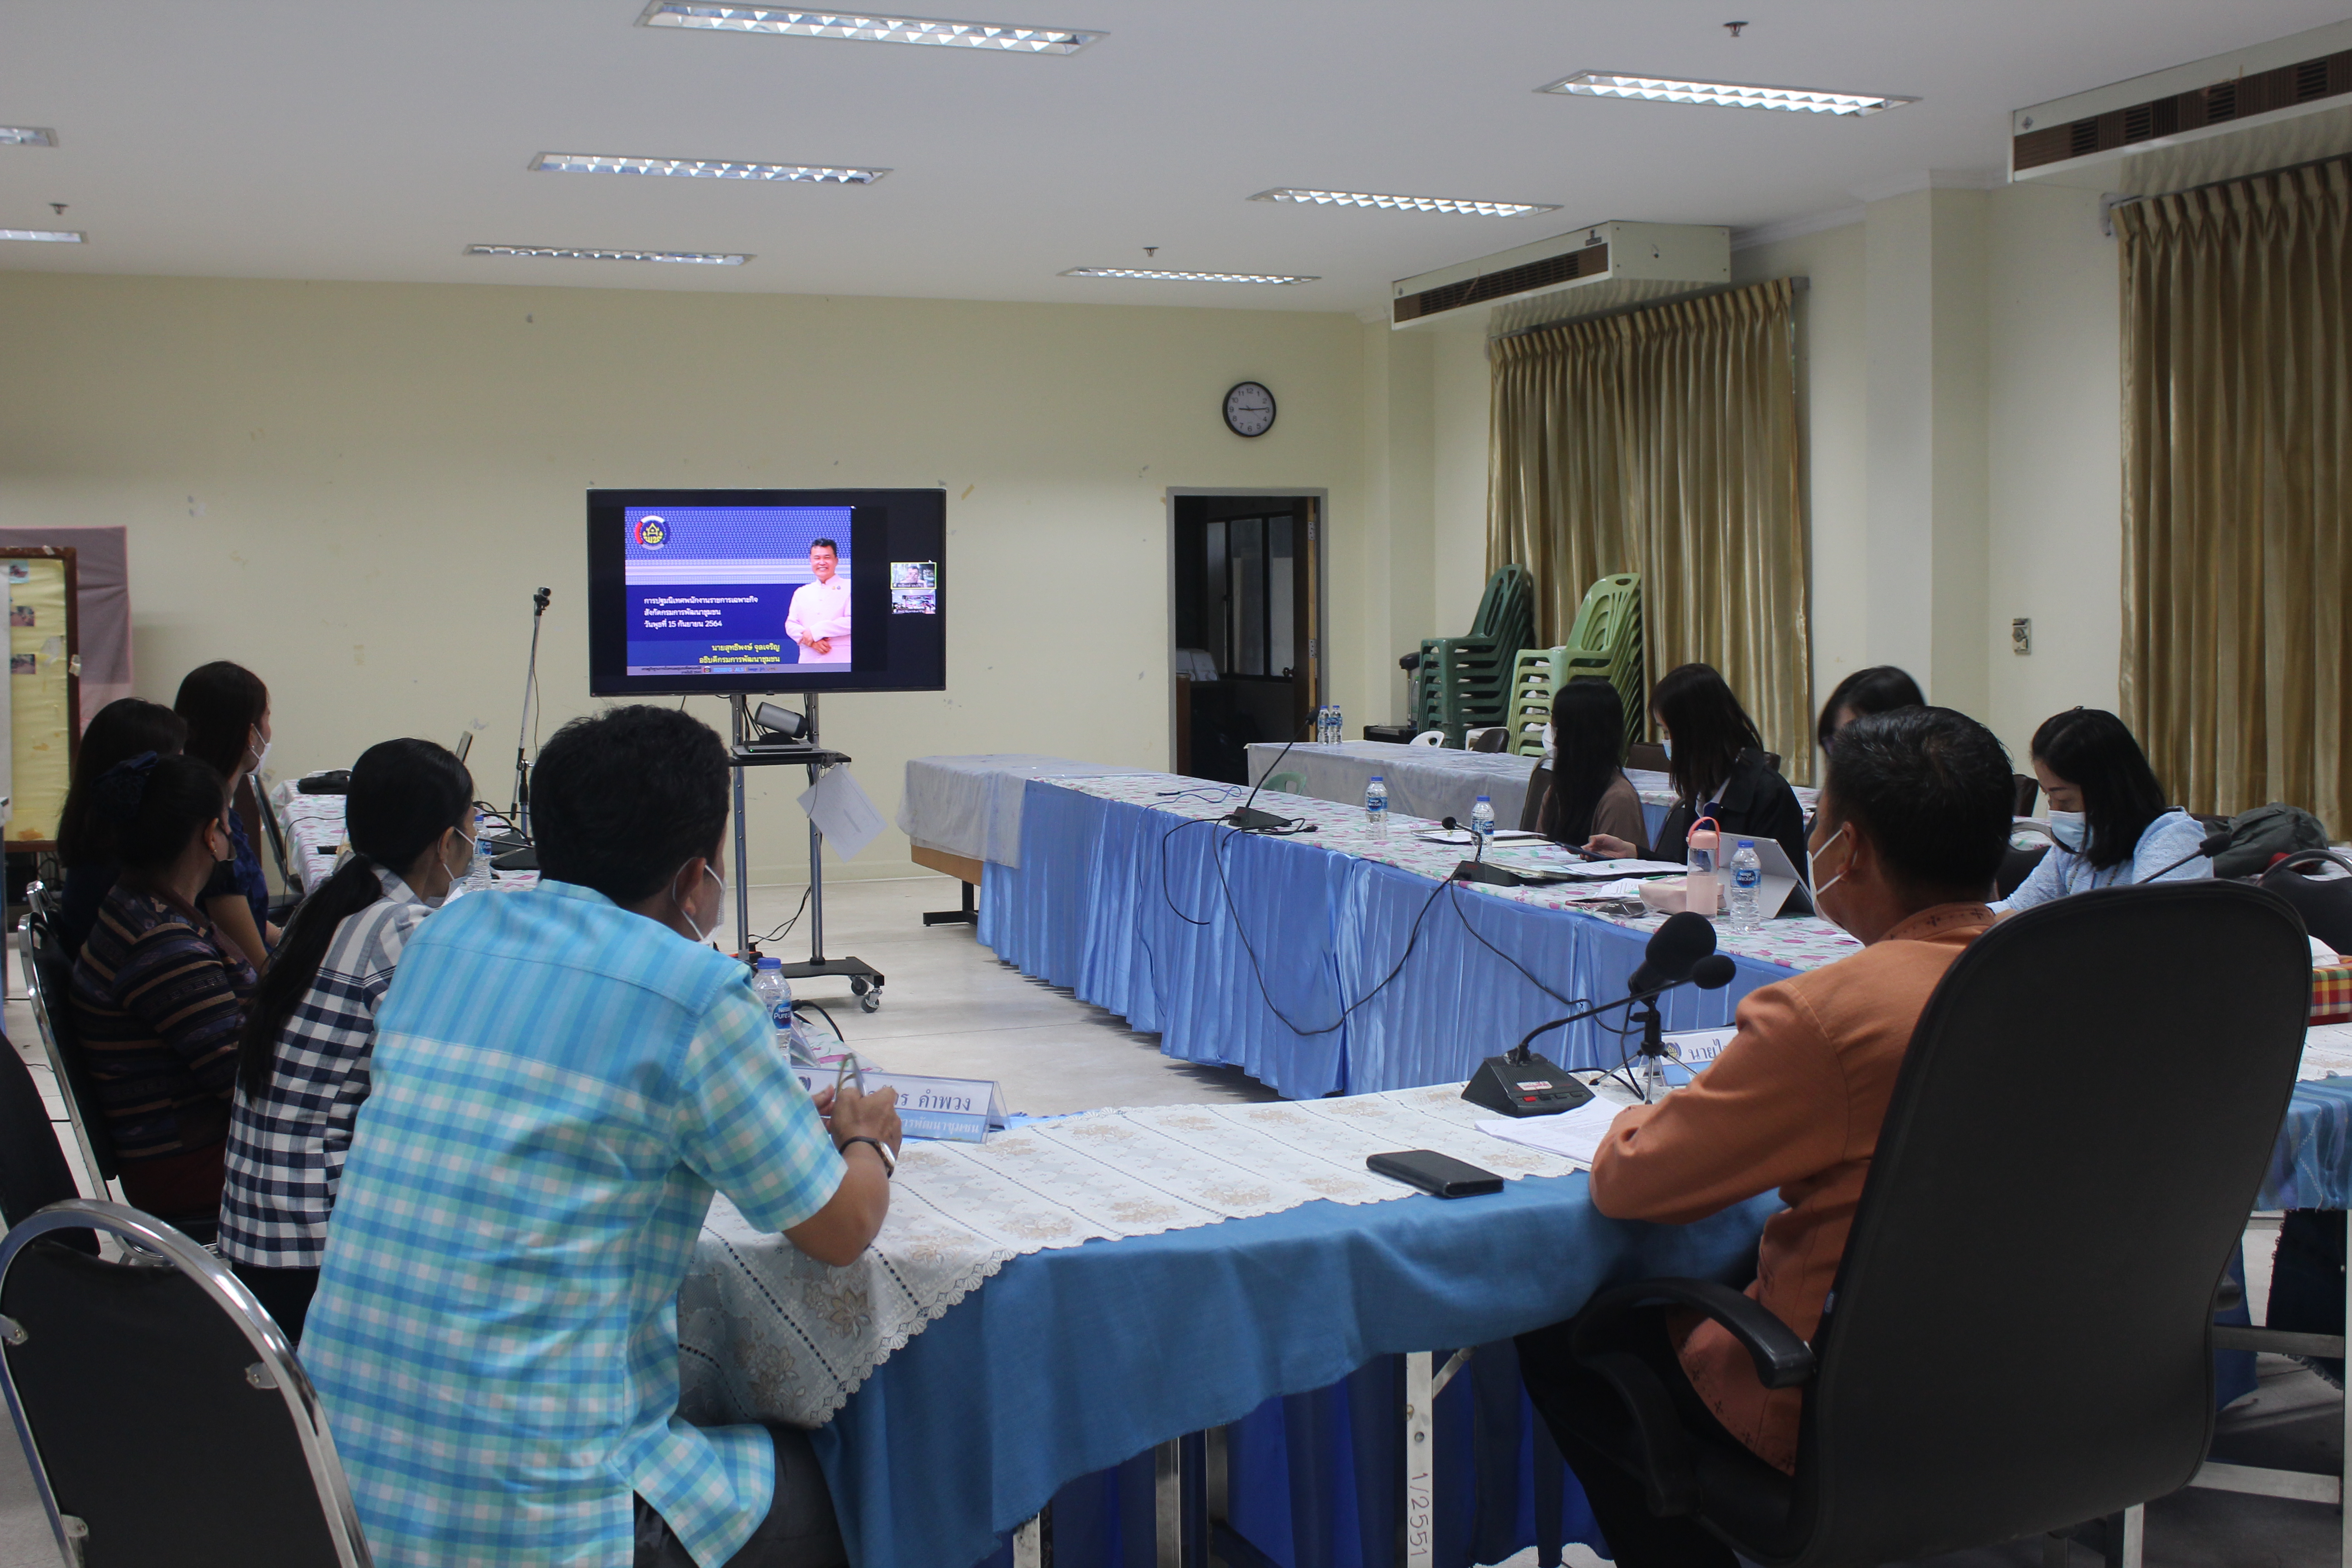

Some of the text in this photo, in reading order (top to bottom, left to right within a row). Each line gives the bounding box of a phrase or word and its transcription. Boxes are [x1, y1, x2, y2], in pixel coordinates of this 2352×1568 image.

[644, 595, 759, 606] การปฐมนิเทศพนักงานราชการเฉพาะกิจ
[644, 608, 721, 617] สังกัดกรมการพัฒนาชุมชน
[644, 618, 667, 630] วันพุธที่
[699, 655, 780, 665] อธิบดีกรมการพัฒนาชุมชน
[1688, 1038, 1727, 1060] นายไ
[918, 1089, 971, 1112] คำพวง
[902, 1116, 979, 1134] ารพัฒนาชุมชน
[1410, 1472, 1429, 1556] 1/2551
